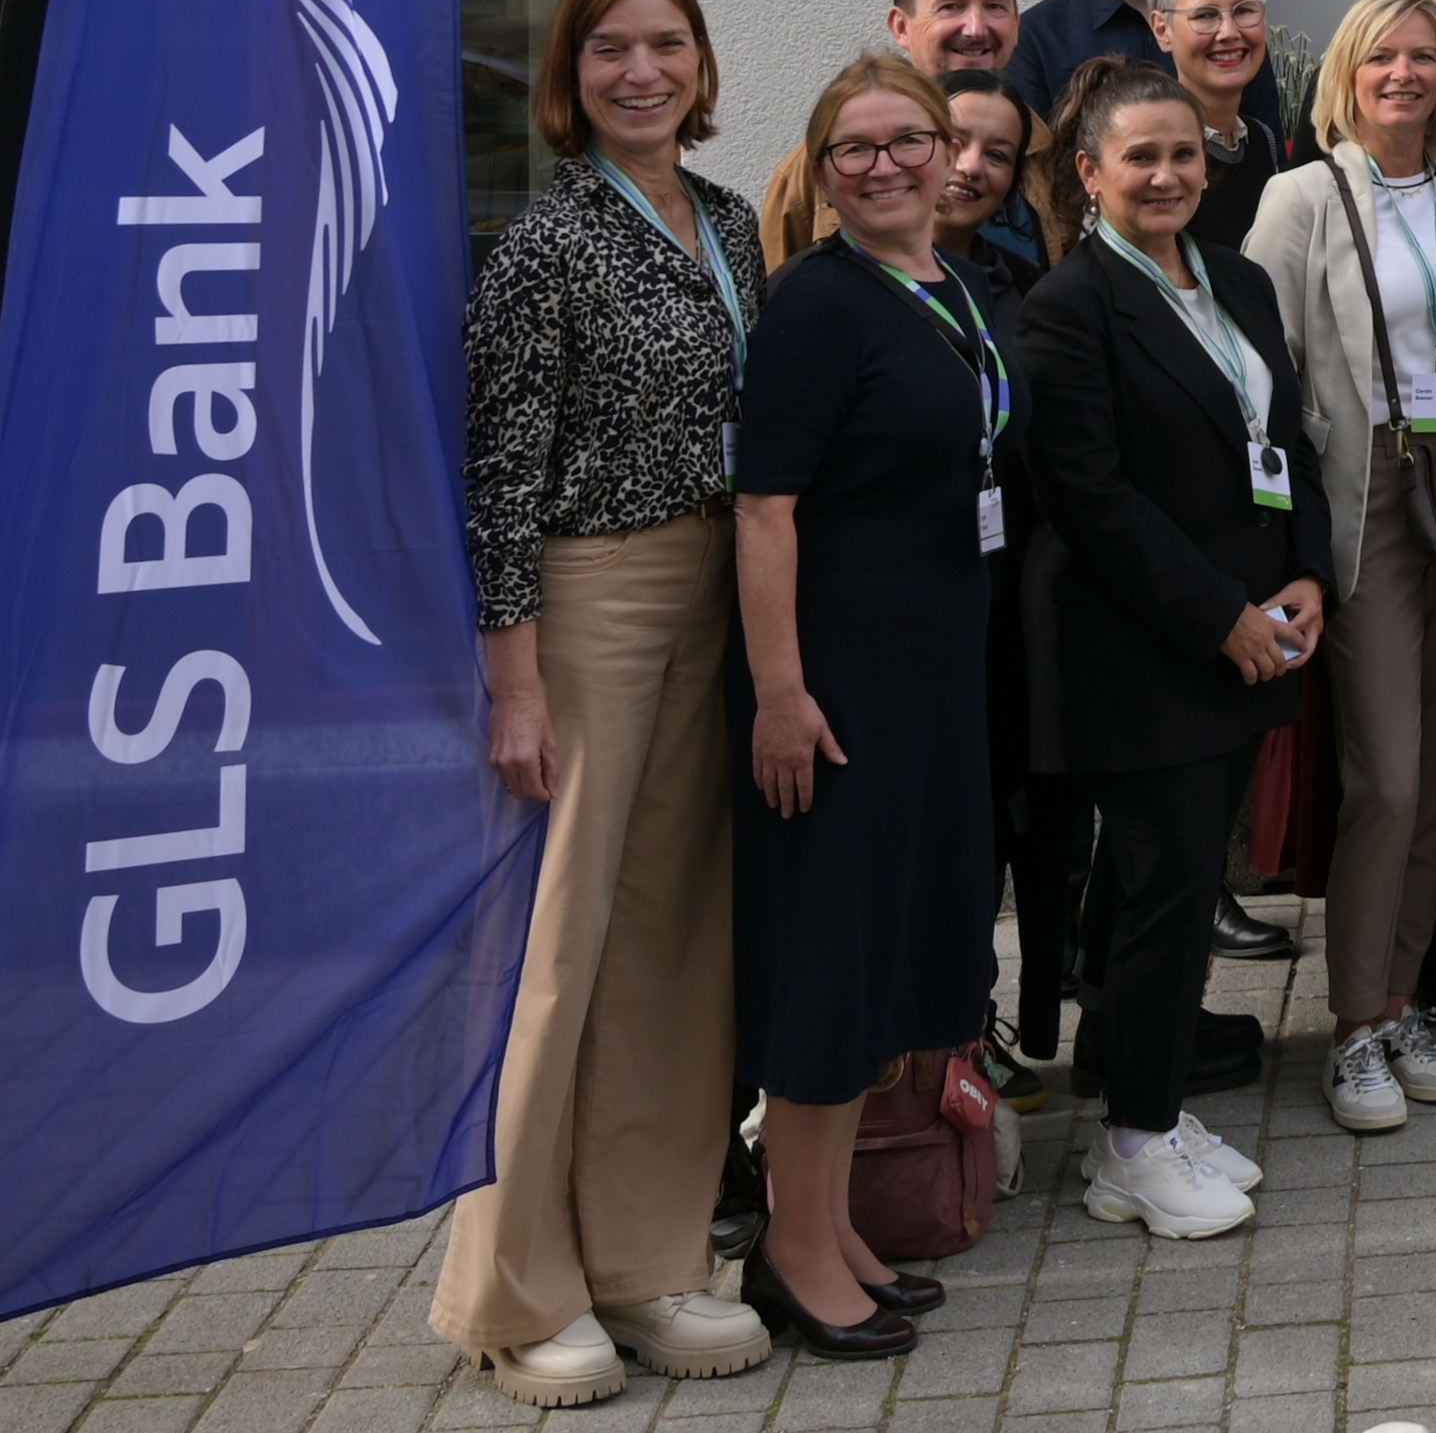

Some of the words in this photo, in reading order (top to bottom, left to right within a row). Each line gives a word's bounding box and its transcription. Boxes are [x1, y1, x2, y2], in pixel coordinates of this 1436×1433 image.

[97, 123, 266, 595] Bank
[79, 649, 252, 1025] GLS
[959, 1078, 989, 1111] OBEY
